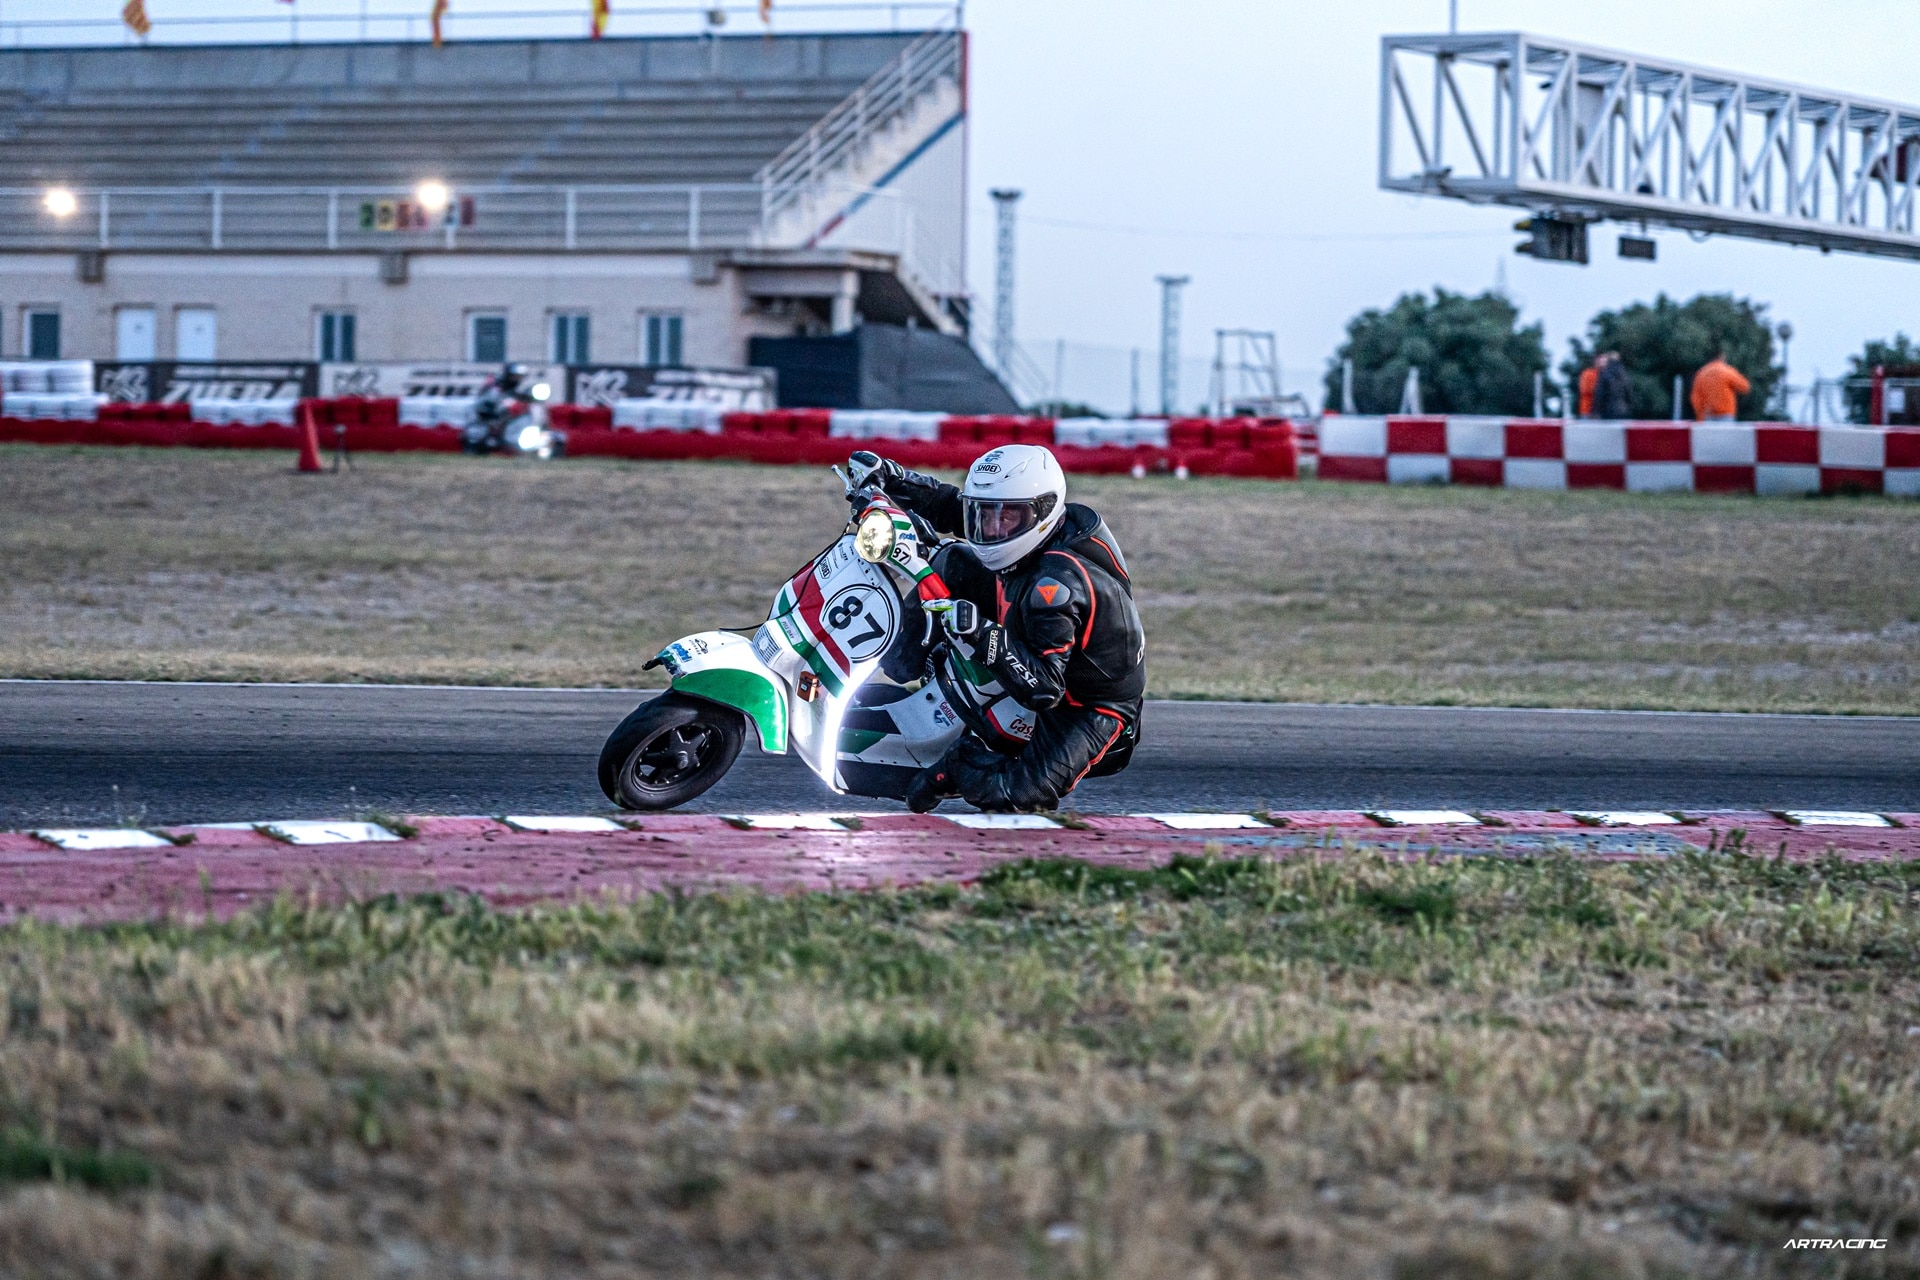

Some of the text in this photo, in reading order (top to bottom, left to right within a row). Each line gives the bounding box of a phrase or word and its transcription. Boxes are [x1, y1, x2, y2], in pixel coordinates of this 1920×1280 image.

[976, 464, 998, 472] SHOEI
[892, 547, 910, 562] 87
[828, 596, 886, 649] 87
[940, 701, 957, 721] Castrol
